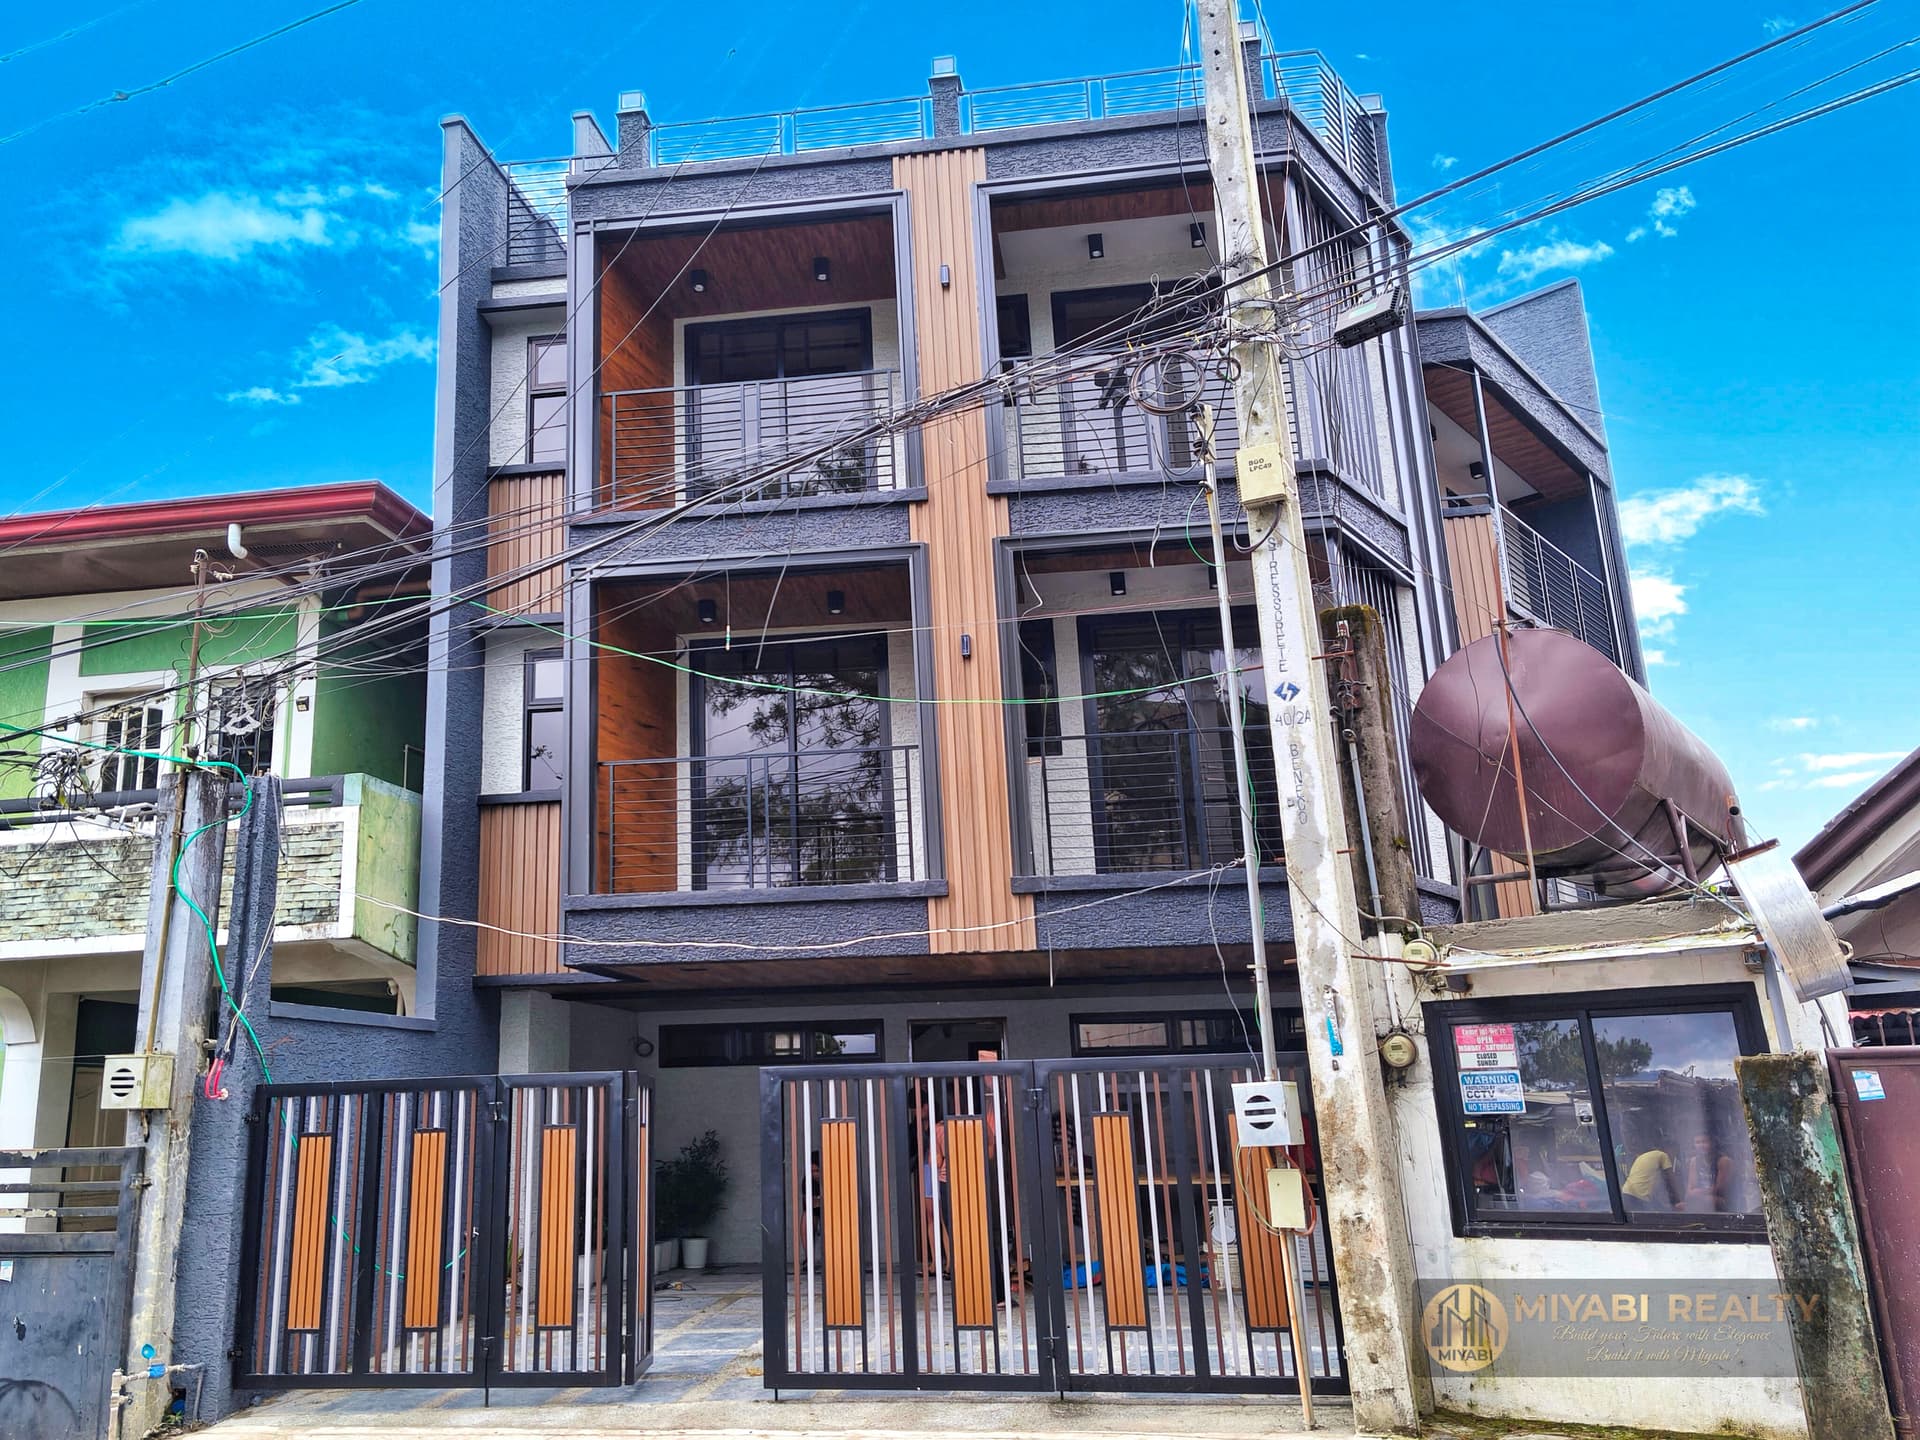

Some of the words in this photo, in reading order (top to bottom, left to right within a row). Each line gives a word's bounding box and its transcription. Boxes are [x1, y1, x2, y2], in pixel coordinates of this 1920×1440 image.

[1463, 1075, 1516, 1085] WARNING
[1466, 1090, 1495, 1099] CCTV
[1467, 1103, 1478, 1112] NO
[1478, 1102, 1521, 1112] TRESPASSING
